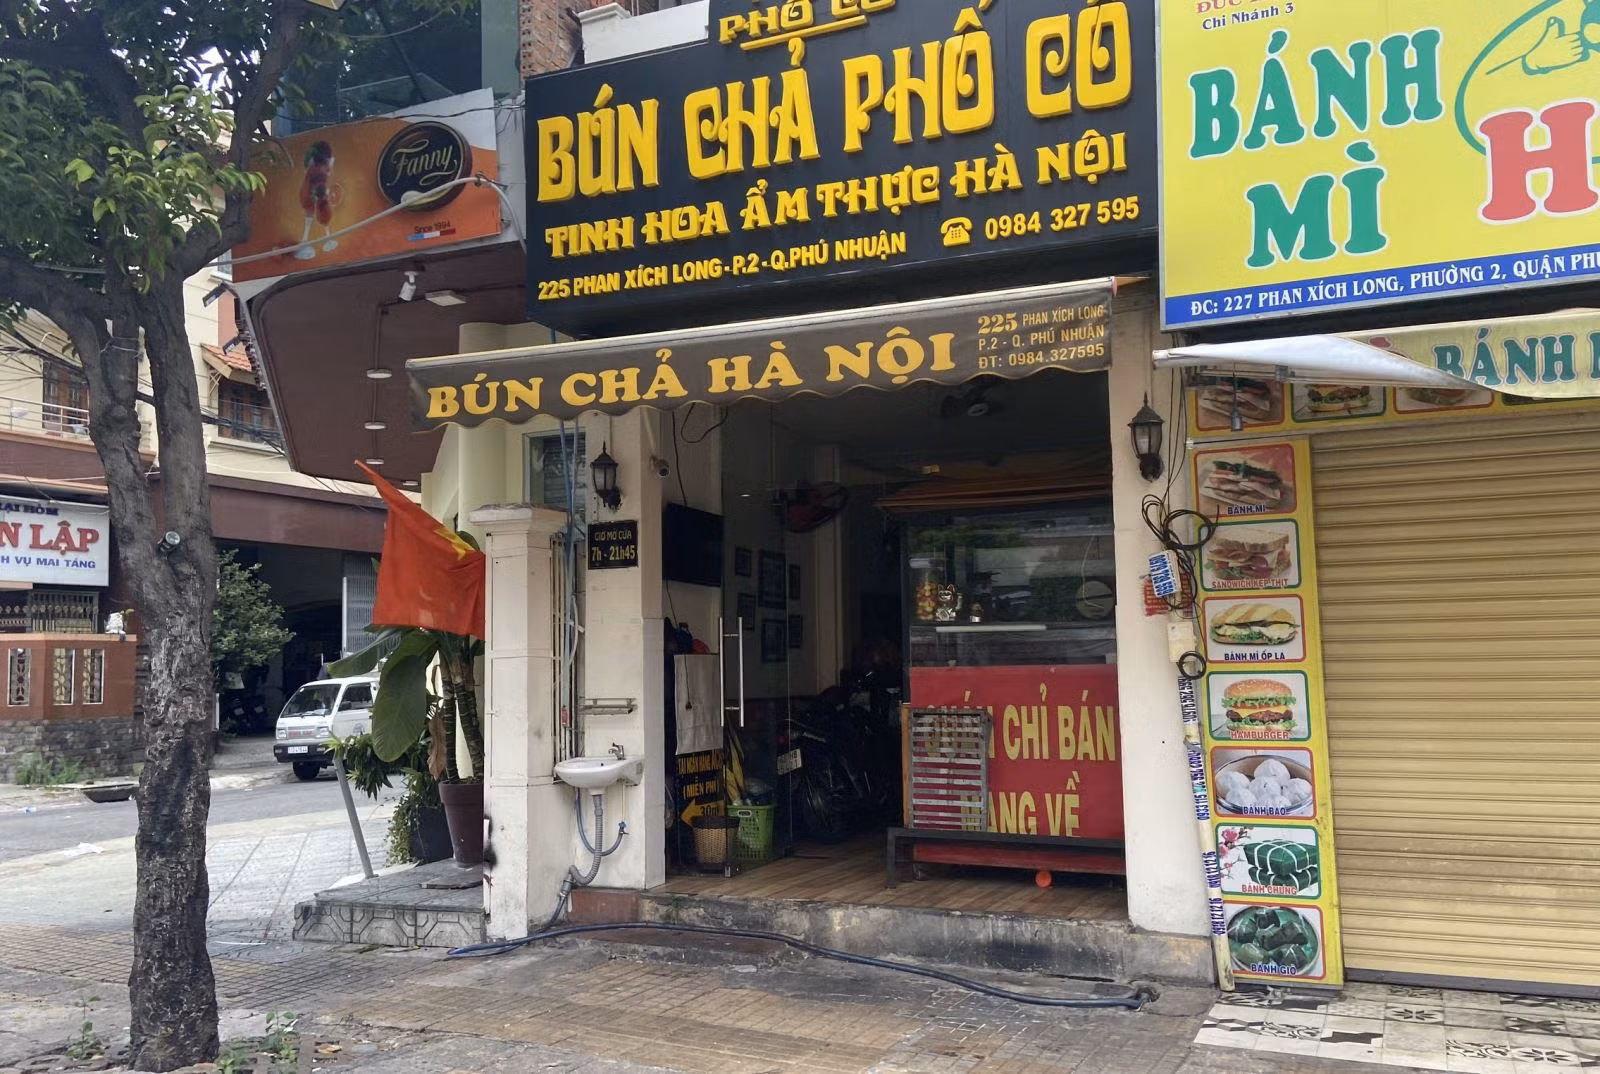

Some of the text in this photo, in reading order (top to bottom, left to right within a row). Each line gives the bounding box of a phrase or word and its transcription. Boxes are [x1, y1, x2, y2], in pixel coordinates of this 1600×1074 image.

[1202, 2, 1294, 30] Chi Nhánh 3
[537, 83, 660, 203] BÚN
[684, 37, 821, 180] CHẢ
[842, 0, 995, 152] PHỐ
[1190, 29, 1443, 158] BÁNH
[386, 138, 458, 186] Fanny
[545, 129, 1128, 258] TINH HOA ẨM THỰC HÀ NỘI
[985, 195, 1140, 241] 0984 327 595
[1247, 141, 1387, 268] MÌ
[538, 278, 571, 301] 225
[573, 271, 621, 298] PHAN
[624, 264, 669, 289] XÍCH
[834, 230, 907, 260] NHUẬN
[1190, 298, 1219, 316] ĐC:
[1223, 293, 1253, 312] 227
[1258, 287, 1303, 308] PHAN
[1307, 280, 1348, 302] XÍCH
[1352, 275, 1404, 296] LONG,
[1409, 263, 1484, 289] PHƯỜNG
[1490, 263, 1507, 280] 2,
[1512, 254, 1565, 279] QUẬN
[977, 304, 1105, 334] 225 PHAN XÍCH LONG
[978, 337, 998, 351] P.2
[1012, 335, 1025, 349] Q.
[1030, 327, 1055, 346] PHÚ
[1060, 324, 1105, 342] NHUẬN
[426, 325, 956, 420] BÚN CHẢ HÀ NỘI
[978, 343, 1105, 369] ĐT: 0984.327595
[1434, 326, 1576, 387] BÁNH
[15, 556, 32, 567] VỤ
[36, 557, 60, 567] MAI
[64, 556, 97, 569] TÁNG
[29, 519, 100, 556] LẬP
[591, 546, 602, 561] 7h
[609, 544, 636, 561] 21h45
[1002, 682, 1049, 760] CHỈ
[1057, 689, 1116, 761] BÁN
[1231, 730, 1290, 740] HAMBURGER
[1044, 770, 1081, 838] VỀ
